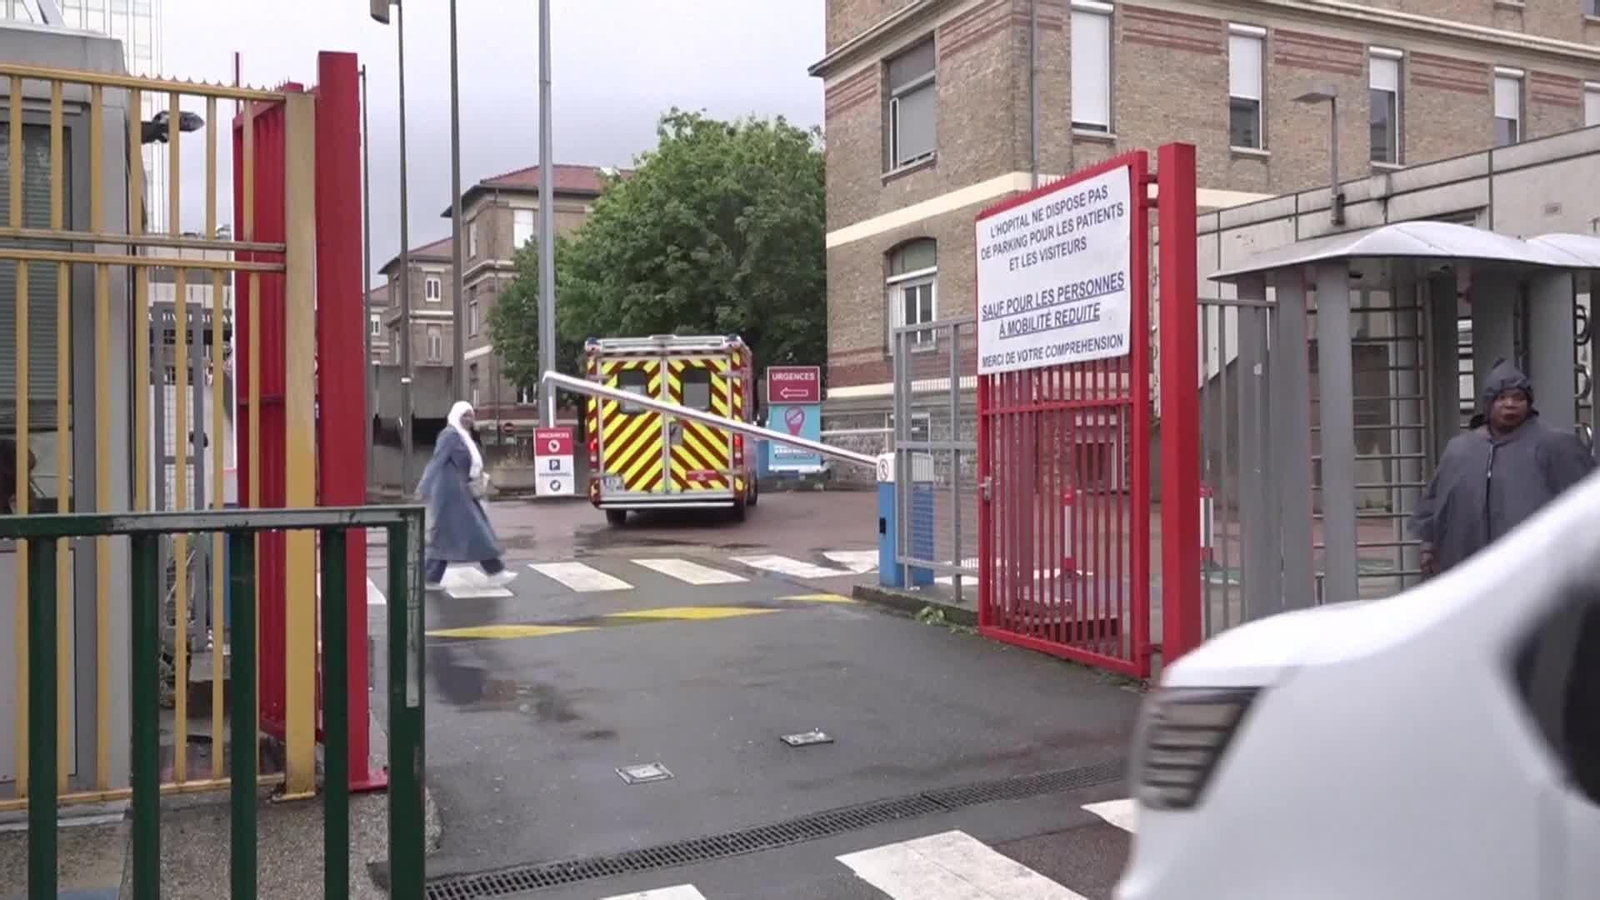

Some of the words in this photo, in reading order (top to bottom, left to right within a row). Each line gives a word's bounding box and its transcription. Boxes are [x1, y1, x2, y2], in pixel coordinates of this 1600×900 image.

[990, 213, 1030, 239] L'HOPITAL
[1031, 207, 1044, 224] NE
[1045, 192, 1086, 216] DISPOSE
[1088, 184, 1108, 204] PAS
[981, 245, 992, 260] DE
[992, 234, 1028, 255] PARKING
[1030, 225, 1054, 246] POUR
[1056, 218, 1075, 237] LES
[1076, 202, 1124, 228] PATIENTS
[1009, 257, 1020, 272] ET
[1021, 251, 1038, 268] LES
[1039, 236, 1087, 262] VISITEURS
[982, 302, 1004, 320] SAUF
[1006, 293, 1033, 313] POUR
[1035, 287, 1055, 306] LES
[1057, 271, 1125, 301] PERSONNES
[1007, 310, 1052, 336] MOBILITÉ
[1054, 302, 1101, 326] REDUITE
[982, 352, 1006, 368] MERCI
[1006, 351, 1015, 364] DE
[1016, 347, 1043, 363] VOTRE
[1044, 333, 1124, 358] COMPREHENSION
[771, 372, 815, 380] URGENCES
